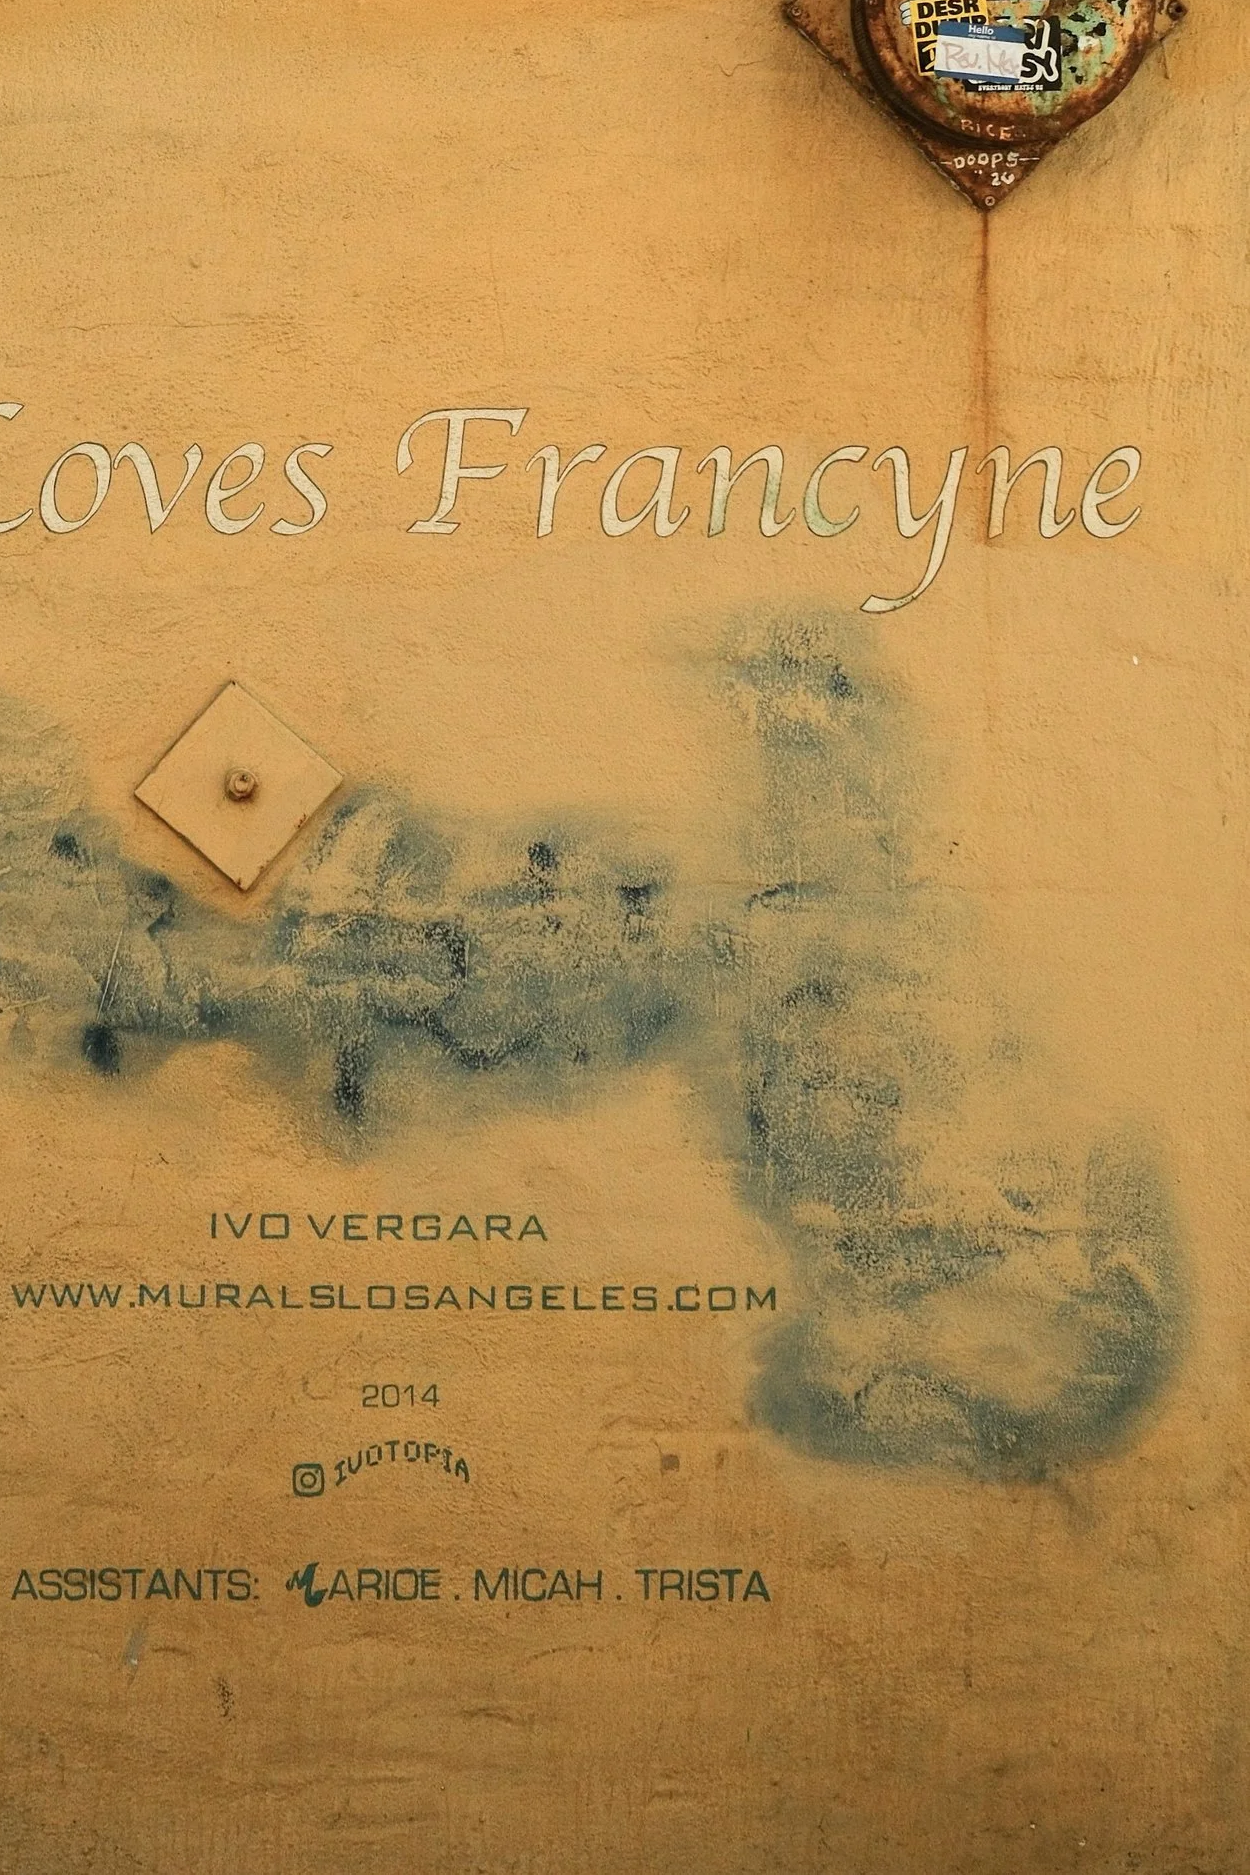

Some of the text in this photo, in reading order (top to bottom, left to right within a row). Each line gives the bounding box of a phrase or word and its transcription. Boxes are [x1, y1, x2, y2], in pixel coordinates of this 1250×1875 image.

[968, 24, 995, 36] Hello
[396, 406, 1144, 614] Francyne
[209, 1212, 548, 1243] IVO VERGARA
[10, 1281, 778, 1313] WWW.MURALSLOSANGELES.COM
[360, 1383, 441, 1409] 2014
[333, 1439, 470, 1487] IVOTOPIA
[10, 1567, 261, 1602] ASSISTANTS:
[473, 1567, 604, 1603] MICAH
[640, 1567, 772, 1604] TRISTA
